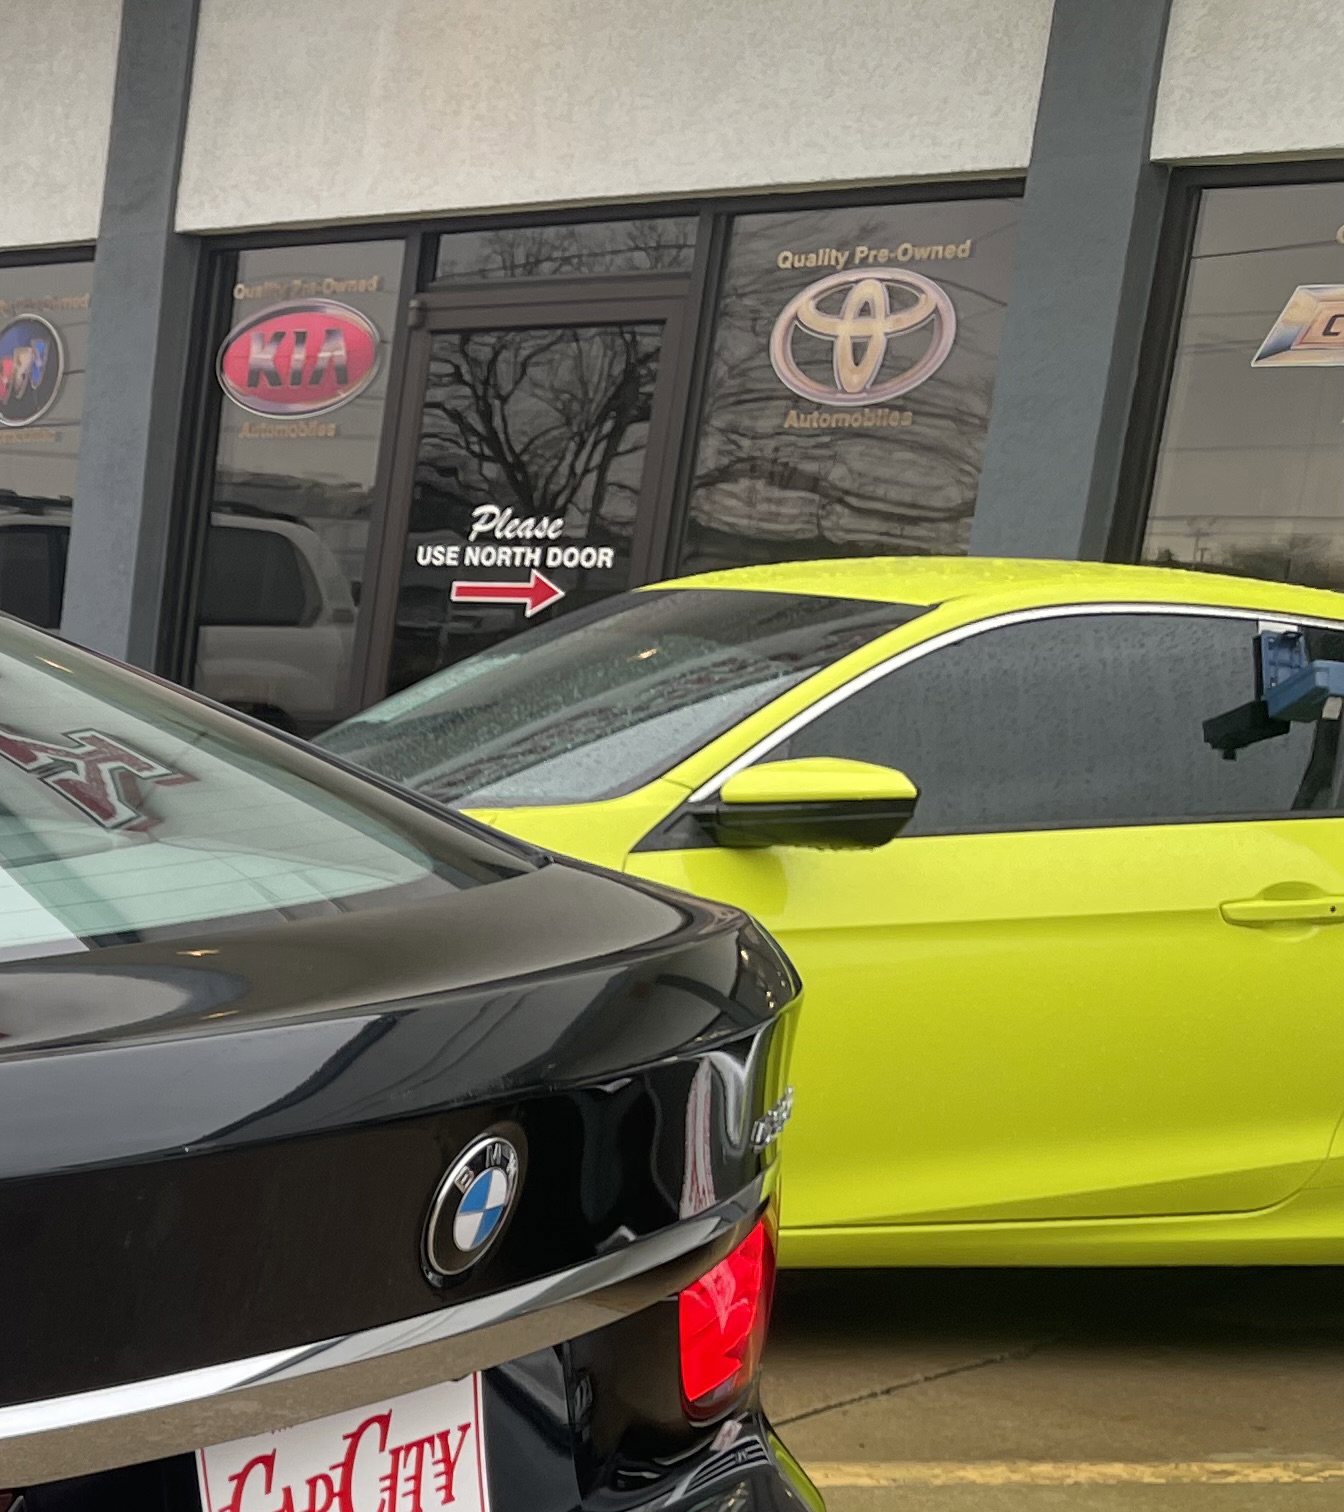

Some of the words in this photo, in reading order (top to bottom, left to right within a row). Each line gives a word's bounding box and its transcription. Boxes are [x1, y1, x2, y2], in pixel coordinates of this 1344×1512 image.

[777, 248, 849, 269] Quality
[854, 239, 972, 264] Pre-Owned
[247, 329, 349, 388] KIA
[784, 408, 912, 428] Automobiles
[468, 503, 564, 542] Please
[417, 545, 460, 567] USE
[464, 545, 542, 568] NORTH
[546, 547, 615, 568] DOOR
